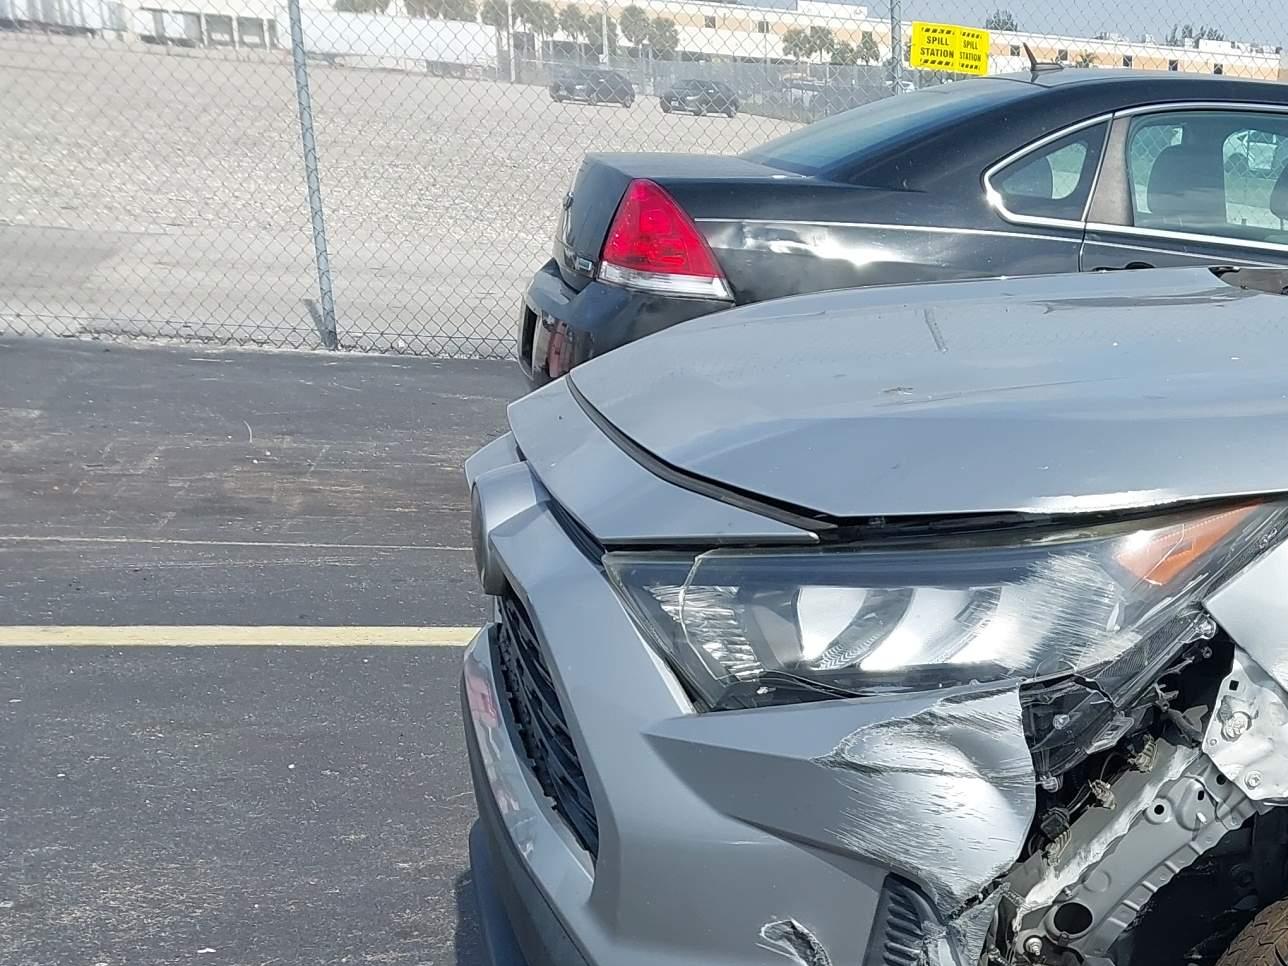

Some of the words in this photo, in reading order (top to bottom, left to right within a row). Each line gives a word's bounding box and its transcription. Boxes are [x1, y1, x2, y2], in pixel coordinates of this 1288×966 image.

[926, 35, 950, 46] SPILL
[962, 39, 979, 50] SPILL
[920, 47, 954, 58] STATION
[959, 51, 982, 62] STATION
